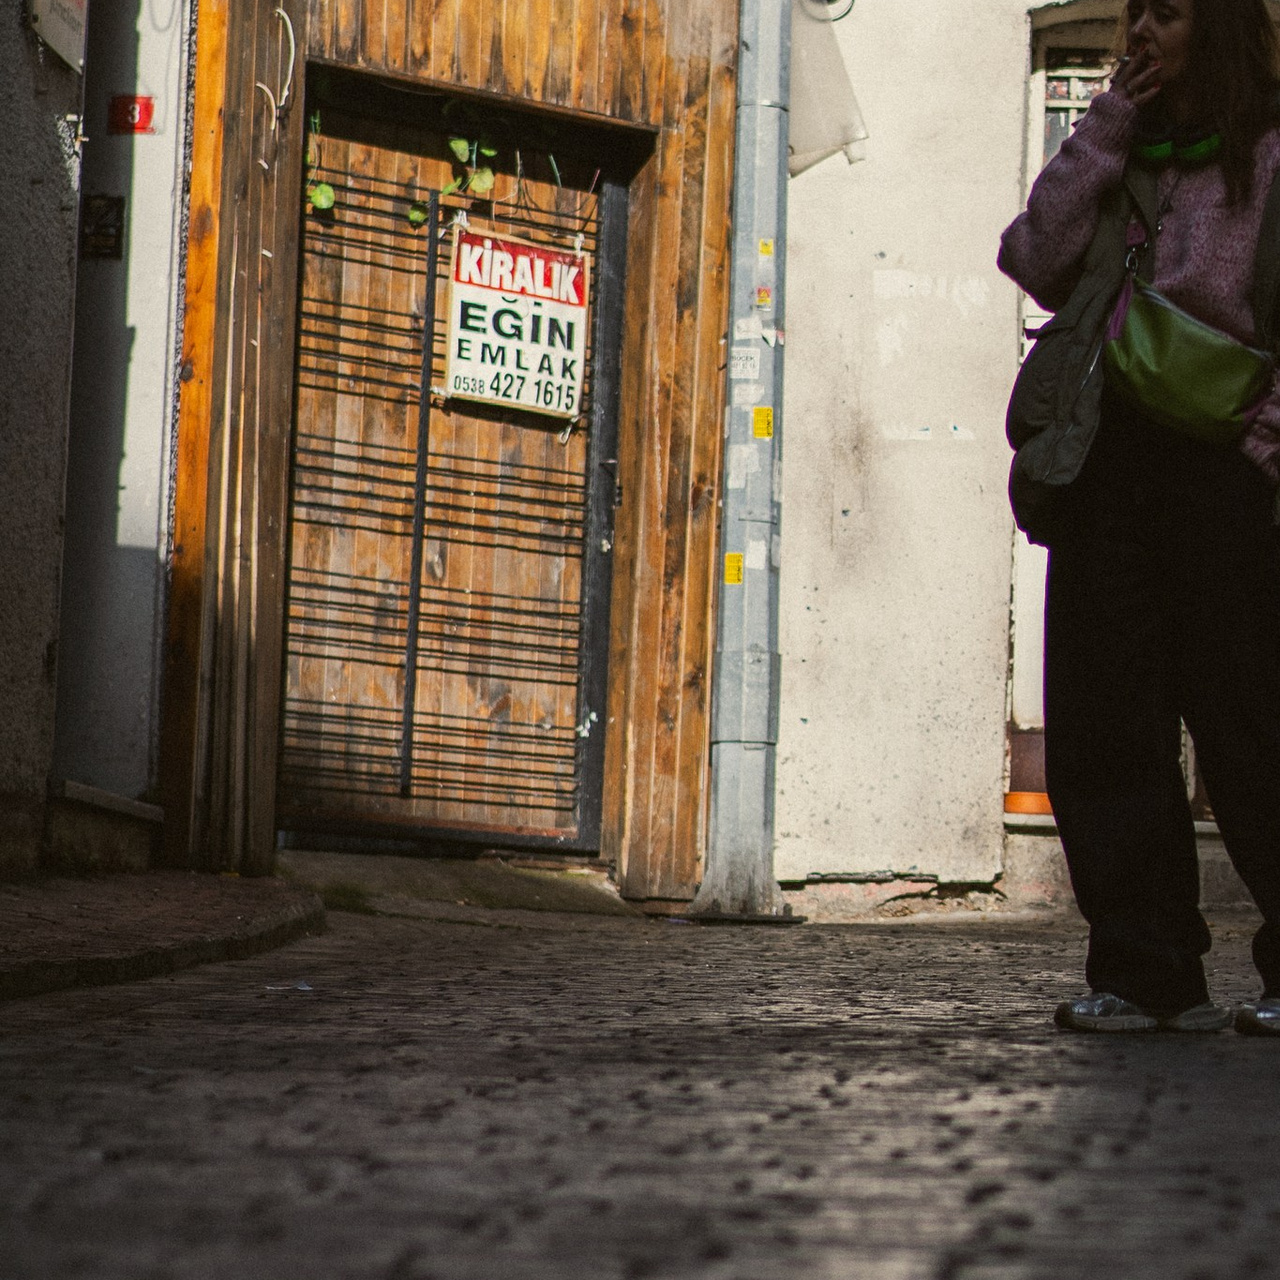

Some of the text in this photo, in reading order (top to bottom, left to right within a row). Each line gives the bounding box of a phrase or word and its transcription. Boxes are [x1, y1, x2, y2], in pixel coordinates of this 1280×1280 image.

[128, 103, 141, 124] 3
[458, 237, 581, 306] KİRALIK
[458, 295, 576, 352] EĞİN
[456, 337, 577, 382] EMLAK
[453, 371, 575, 412] 0538 427 1615
